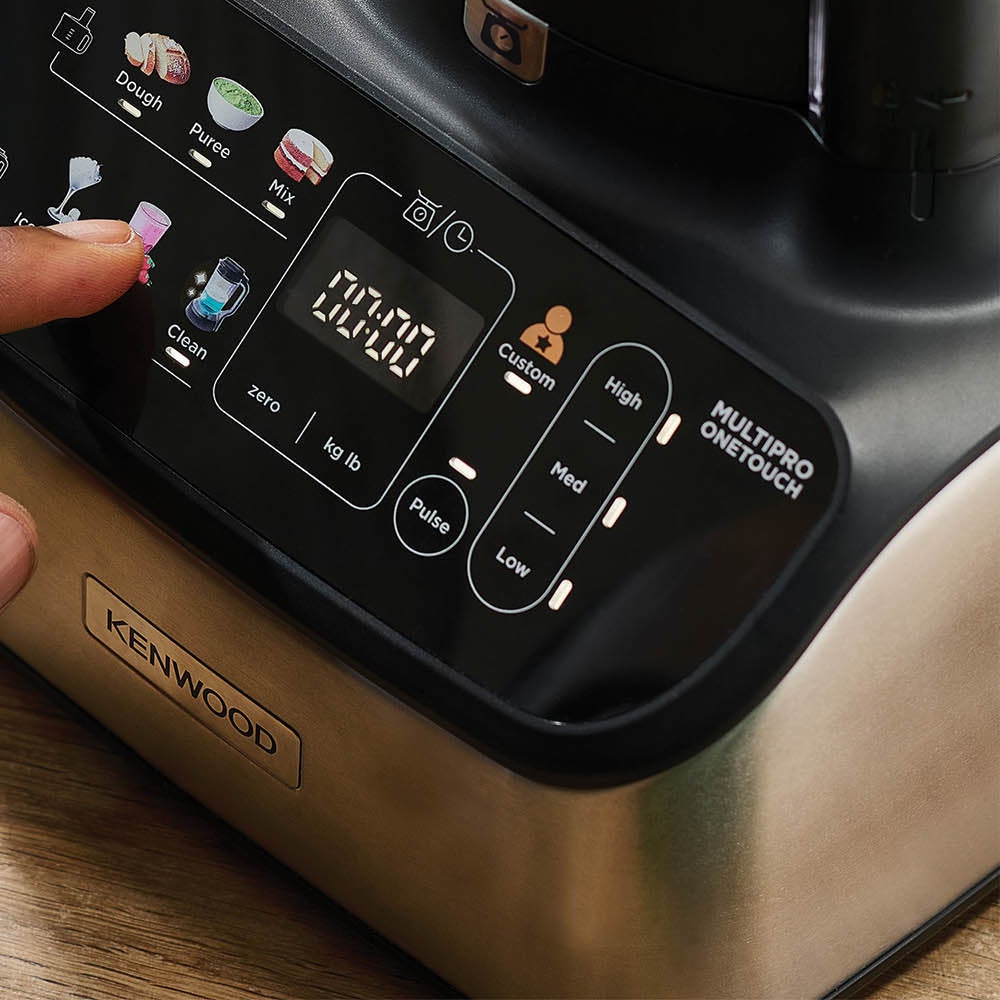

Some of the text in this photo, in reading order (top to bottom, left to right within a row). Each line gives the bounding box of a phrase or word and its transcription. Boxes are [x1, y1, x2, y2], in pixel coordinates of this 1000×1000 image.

[115, 70, 163, 112] Dough
[188, 122, 231, 160] Puree
[268, 178, 296, 206] Mix
[167, 324, 208, 361] Clean
[312, 269, 436, 379] 00:00
[498, 342, 556, 391] Custom
[247, 384, 281, 413] zero
[604, 375, 642, 411] High
[323, 436, 361, 472] kg lb
[710, 399, 814, 480] MULTIPRO
[550, 460, 588, 494] Med
[700, 420, 803, 500] ONETOUCH
[408, 498, 450, 535] Pulse
[495, 545, 531, 578] Low
[106, 608, 277, 755] KENWOOD
